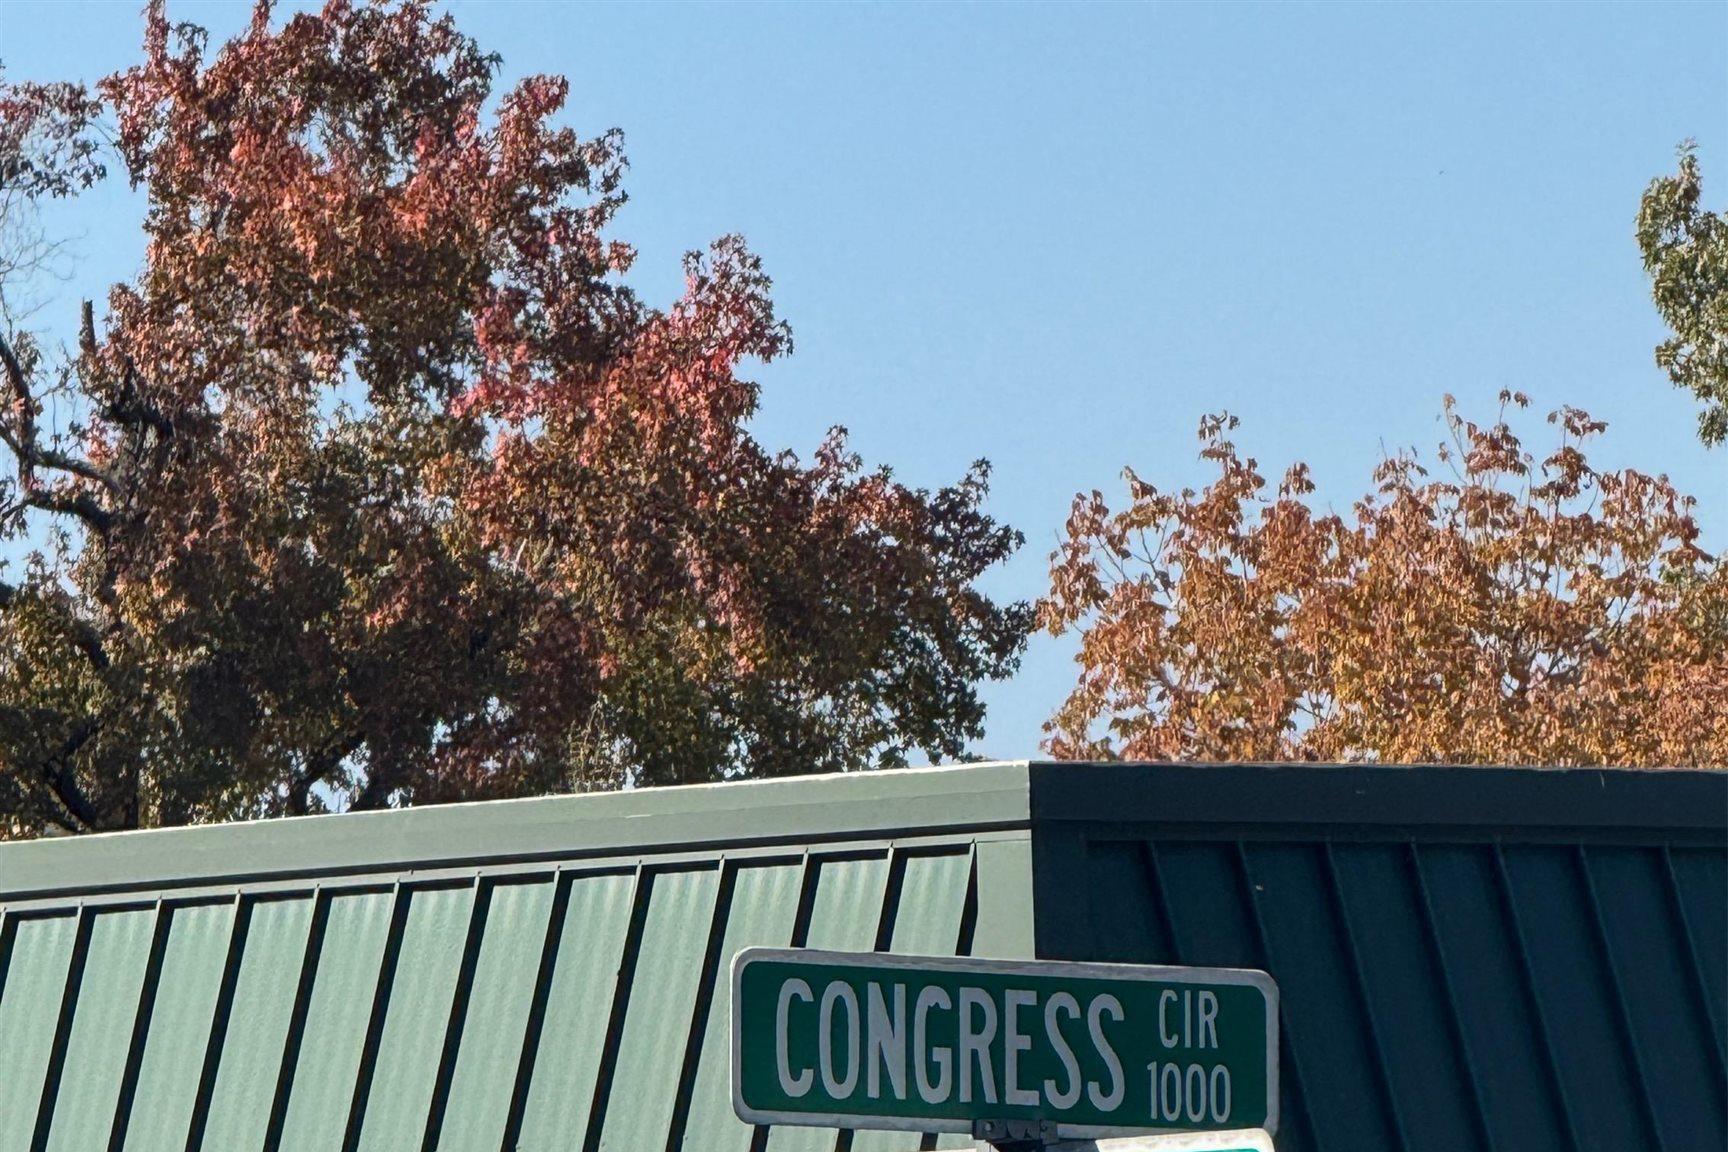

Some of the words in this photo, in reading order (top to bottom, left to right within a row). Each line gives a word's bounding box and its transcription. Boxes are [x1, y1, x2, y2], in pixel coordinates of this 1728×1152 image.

[775, 978, 1125, 1111] CONGRESS
[1158, 989, 1220, 1049] CIR
[1147, 1061, 1231, 1123] 1000
